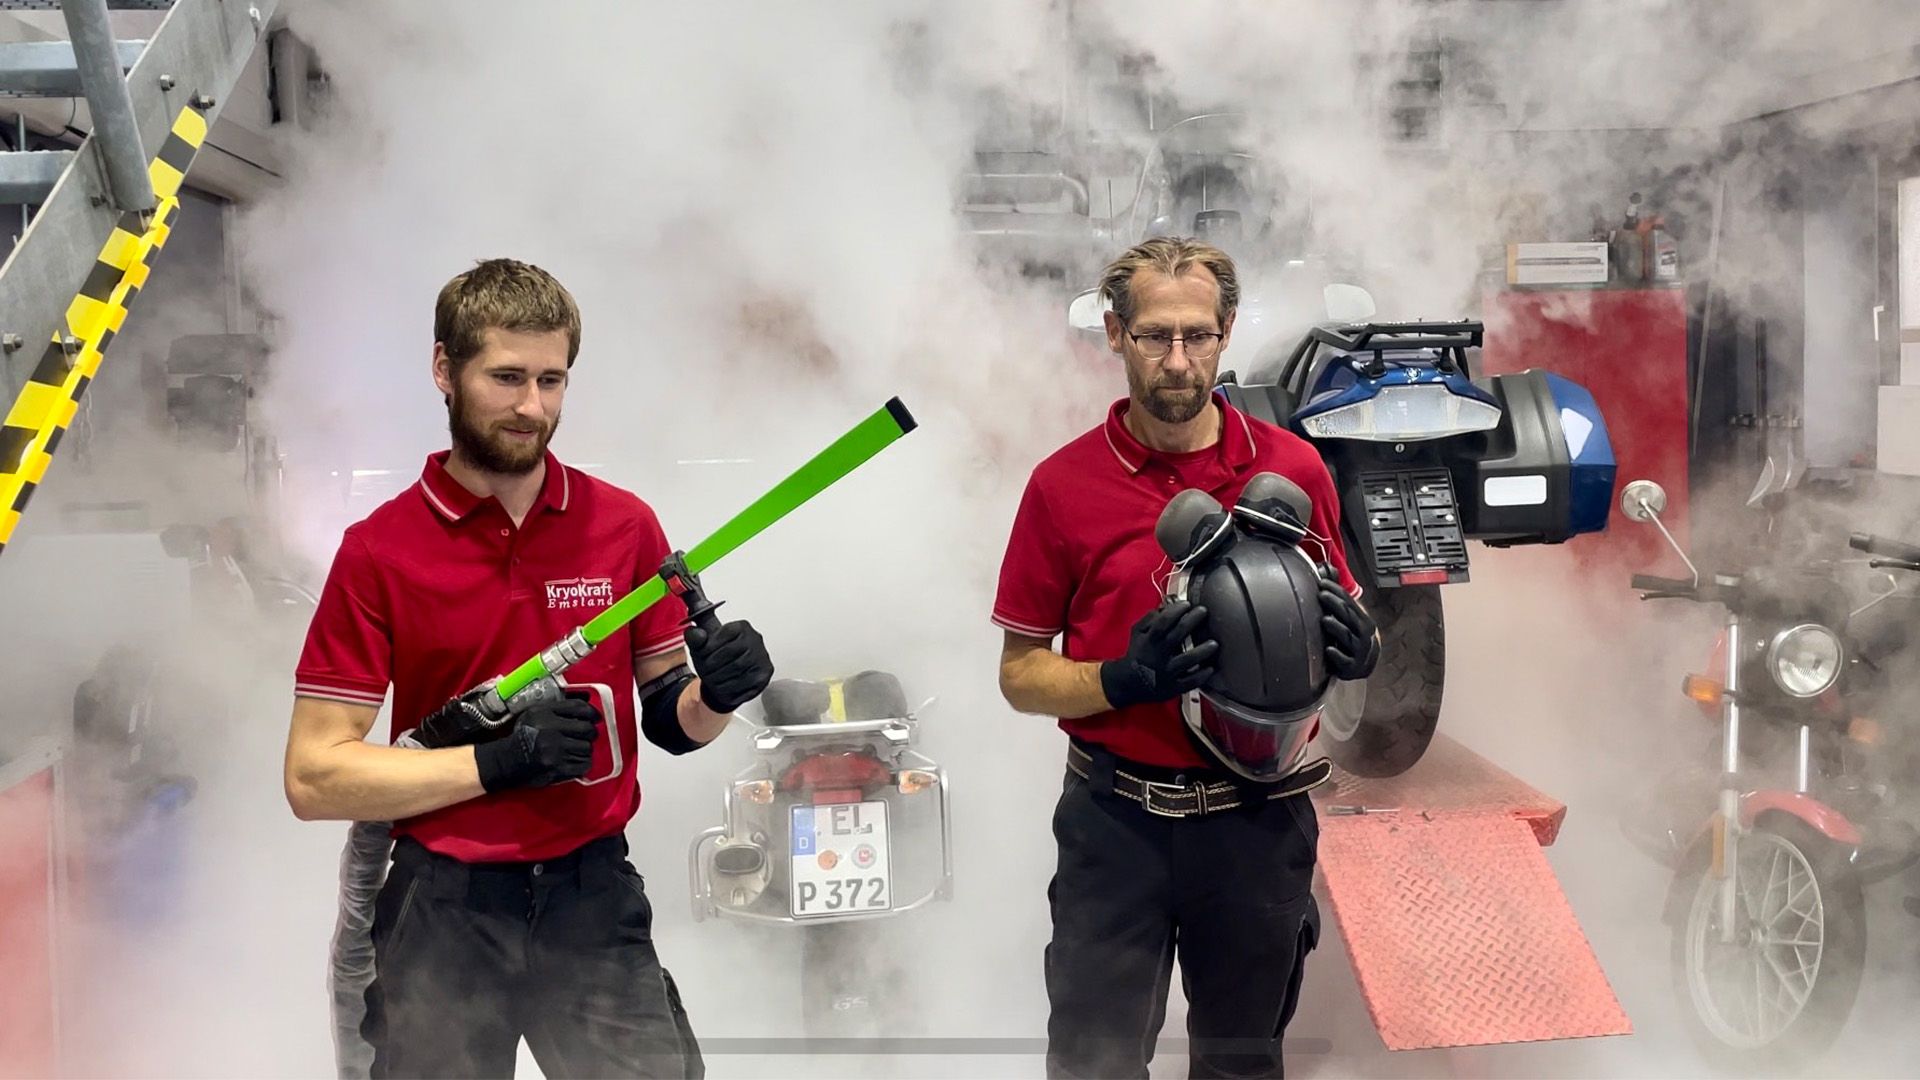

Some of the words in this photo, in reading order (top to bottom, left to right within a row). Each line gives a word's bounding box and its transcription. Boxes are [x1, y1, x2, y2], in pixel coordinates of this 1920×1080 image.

[546, 582, 612, 599] KryoKraft
[547, 595, 612, 608] Emsland
[831, 805, 872, 835] EL
[798, 836, 809, 849] D
[798, 881, 817, 911] P
[825, 877, 886, 910] 372
